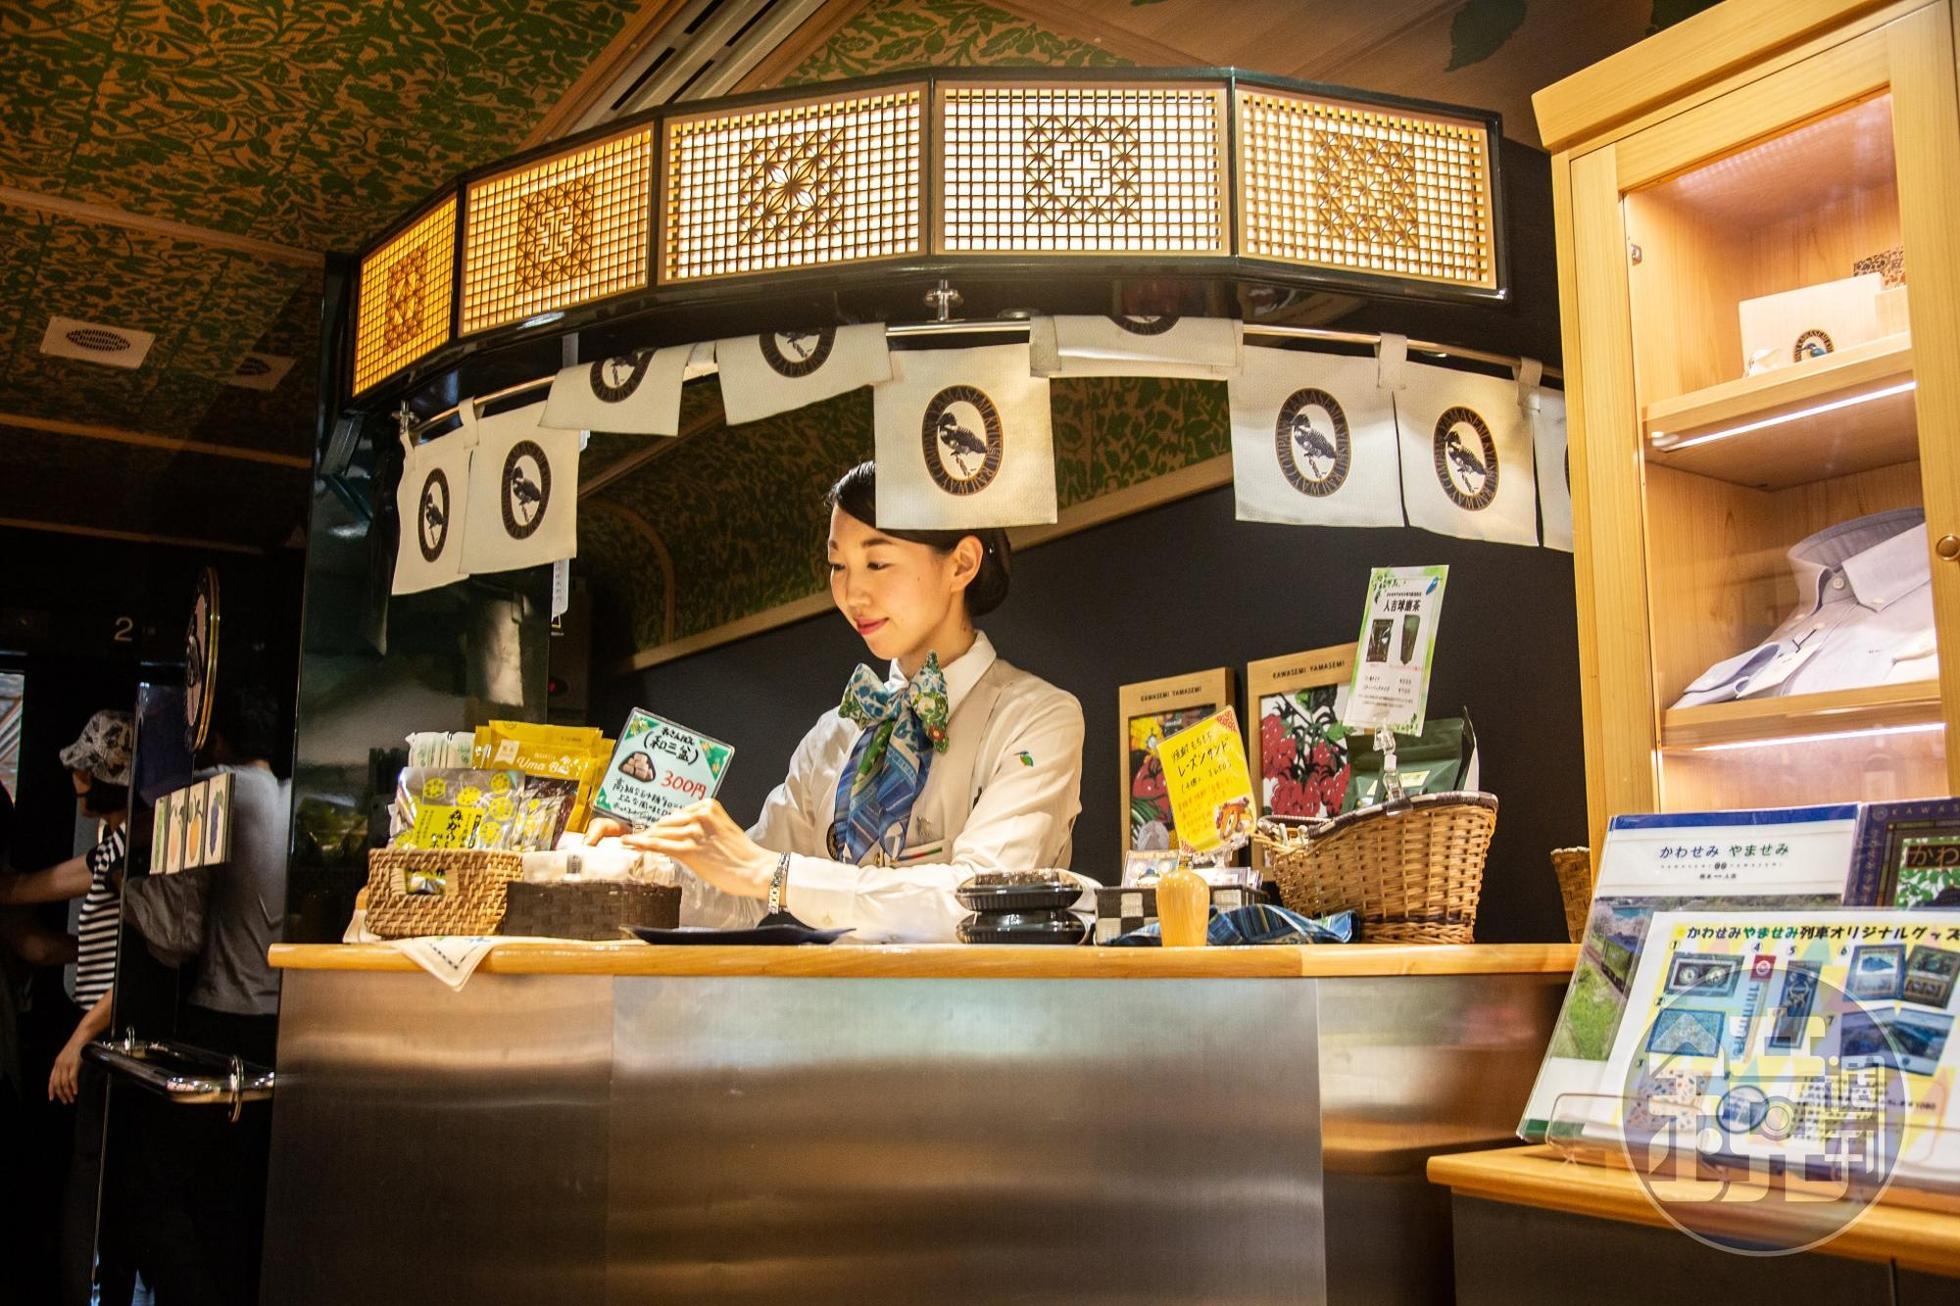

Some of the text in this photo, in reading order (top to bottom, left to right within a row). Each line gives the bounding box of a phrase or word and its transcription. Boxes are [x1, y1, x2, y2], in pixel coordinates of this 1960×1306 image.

[940, 464, 995, 494] RAILWAY
[1290, 467, 1342, 496] RAILWAY
[1383, 600, 1421, 612] 人吉球磨茶
[114, 617, 133, 642] 2
[1272, 660, 1345, 679] KAWASEMI YAMASEMI
[1172, 686, 1202, 697] YAMASEMI
[517, 756, 545, 771] Uma
[661, 769, 708, 801] 300円
[1659, 843, 1789, 858] かわせみ やませみ
[1909, 843, 1960, 869] かわ
